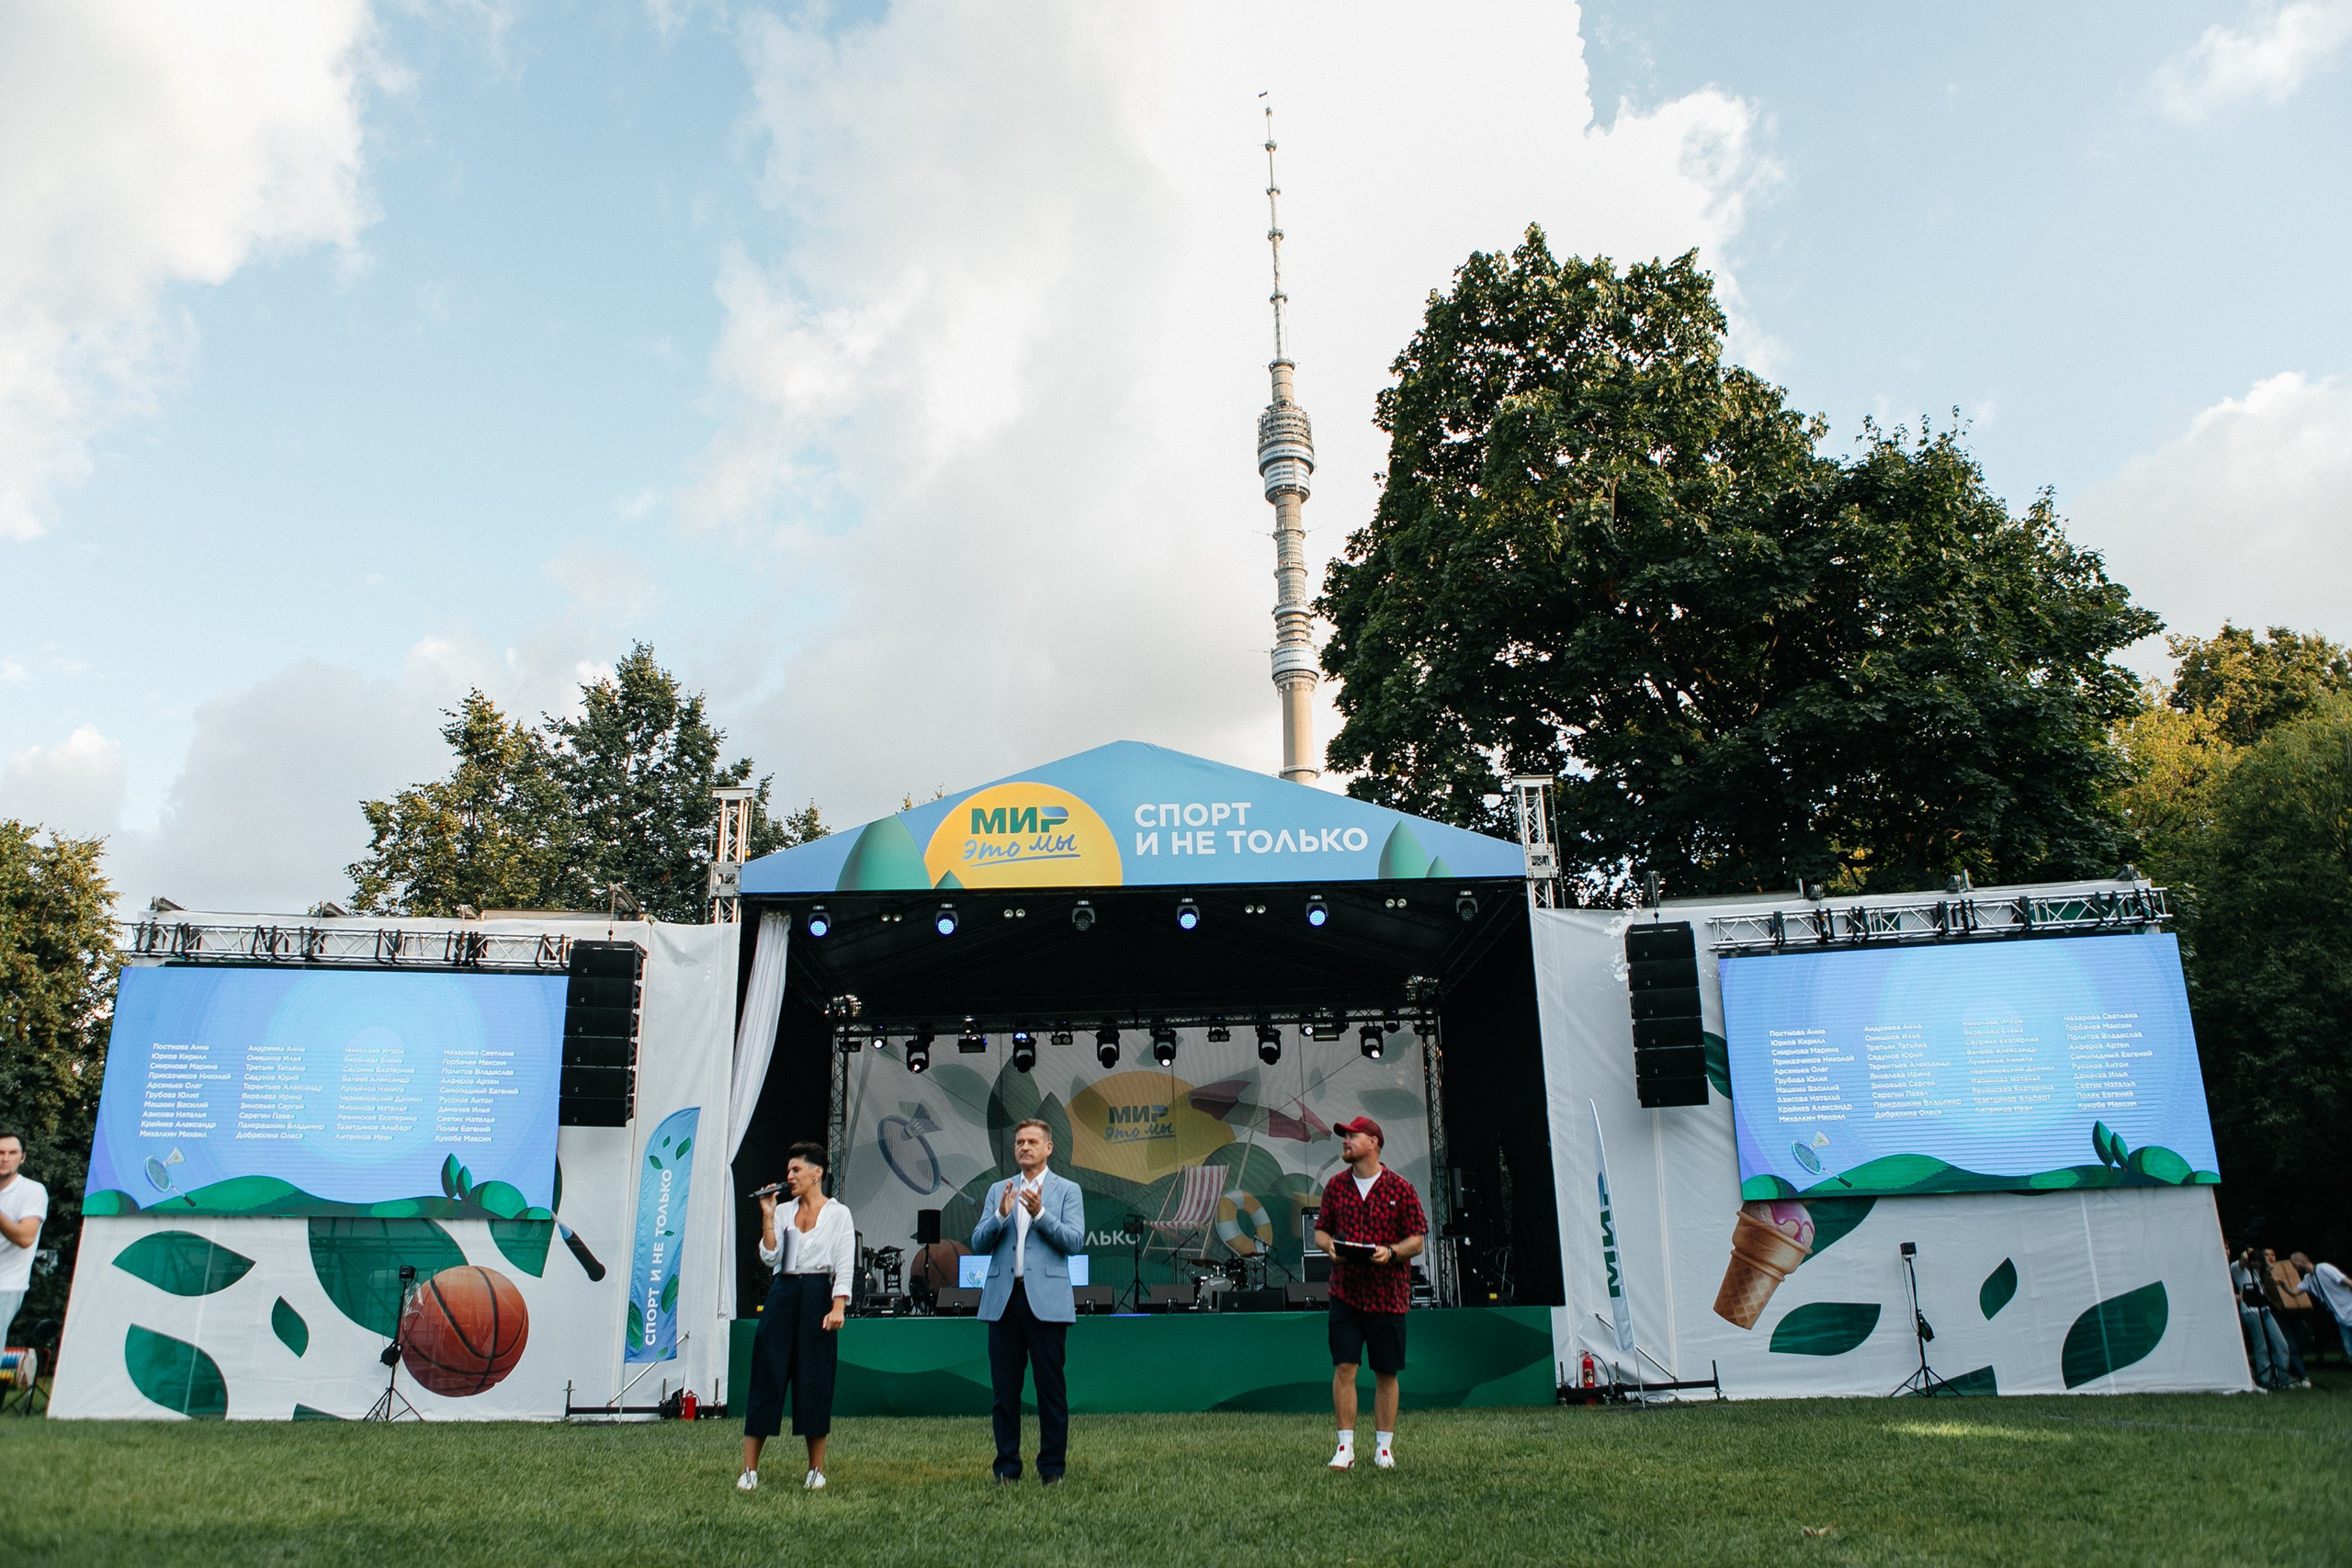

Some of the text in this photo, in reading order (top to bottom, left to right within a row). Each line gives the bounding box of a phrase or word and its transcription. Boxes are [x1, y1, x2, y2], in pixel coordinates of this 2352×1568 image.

[971, 807, 1069, 834] МИР
[1135, 802, 1251, 828] СПОРТ
[1136, 827, 1369, 856] И НЕ ТОЛЬКО
[1109, 1105, 1169, 1123] МИР
[1085, 1229, 1141, 1247] ЛЬКО
[645, 1169, 672, 1346] СПОРТ И НЕ ТОЛЬКО
